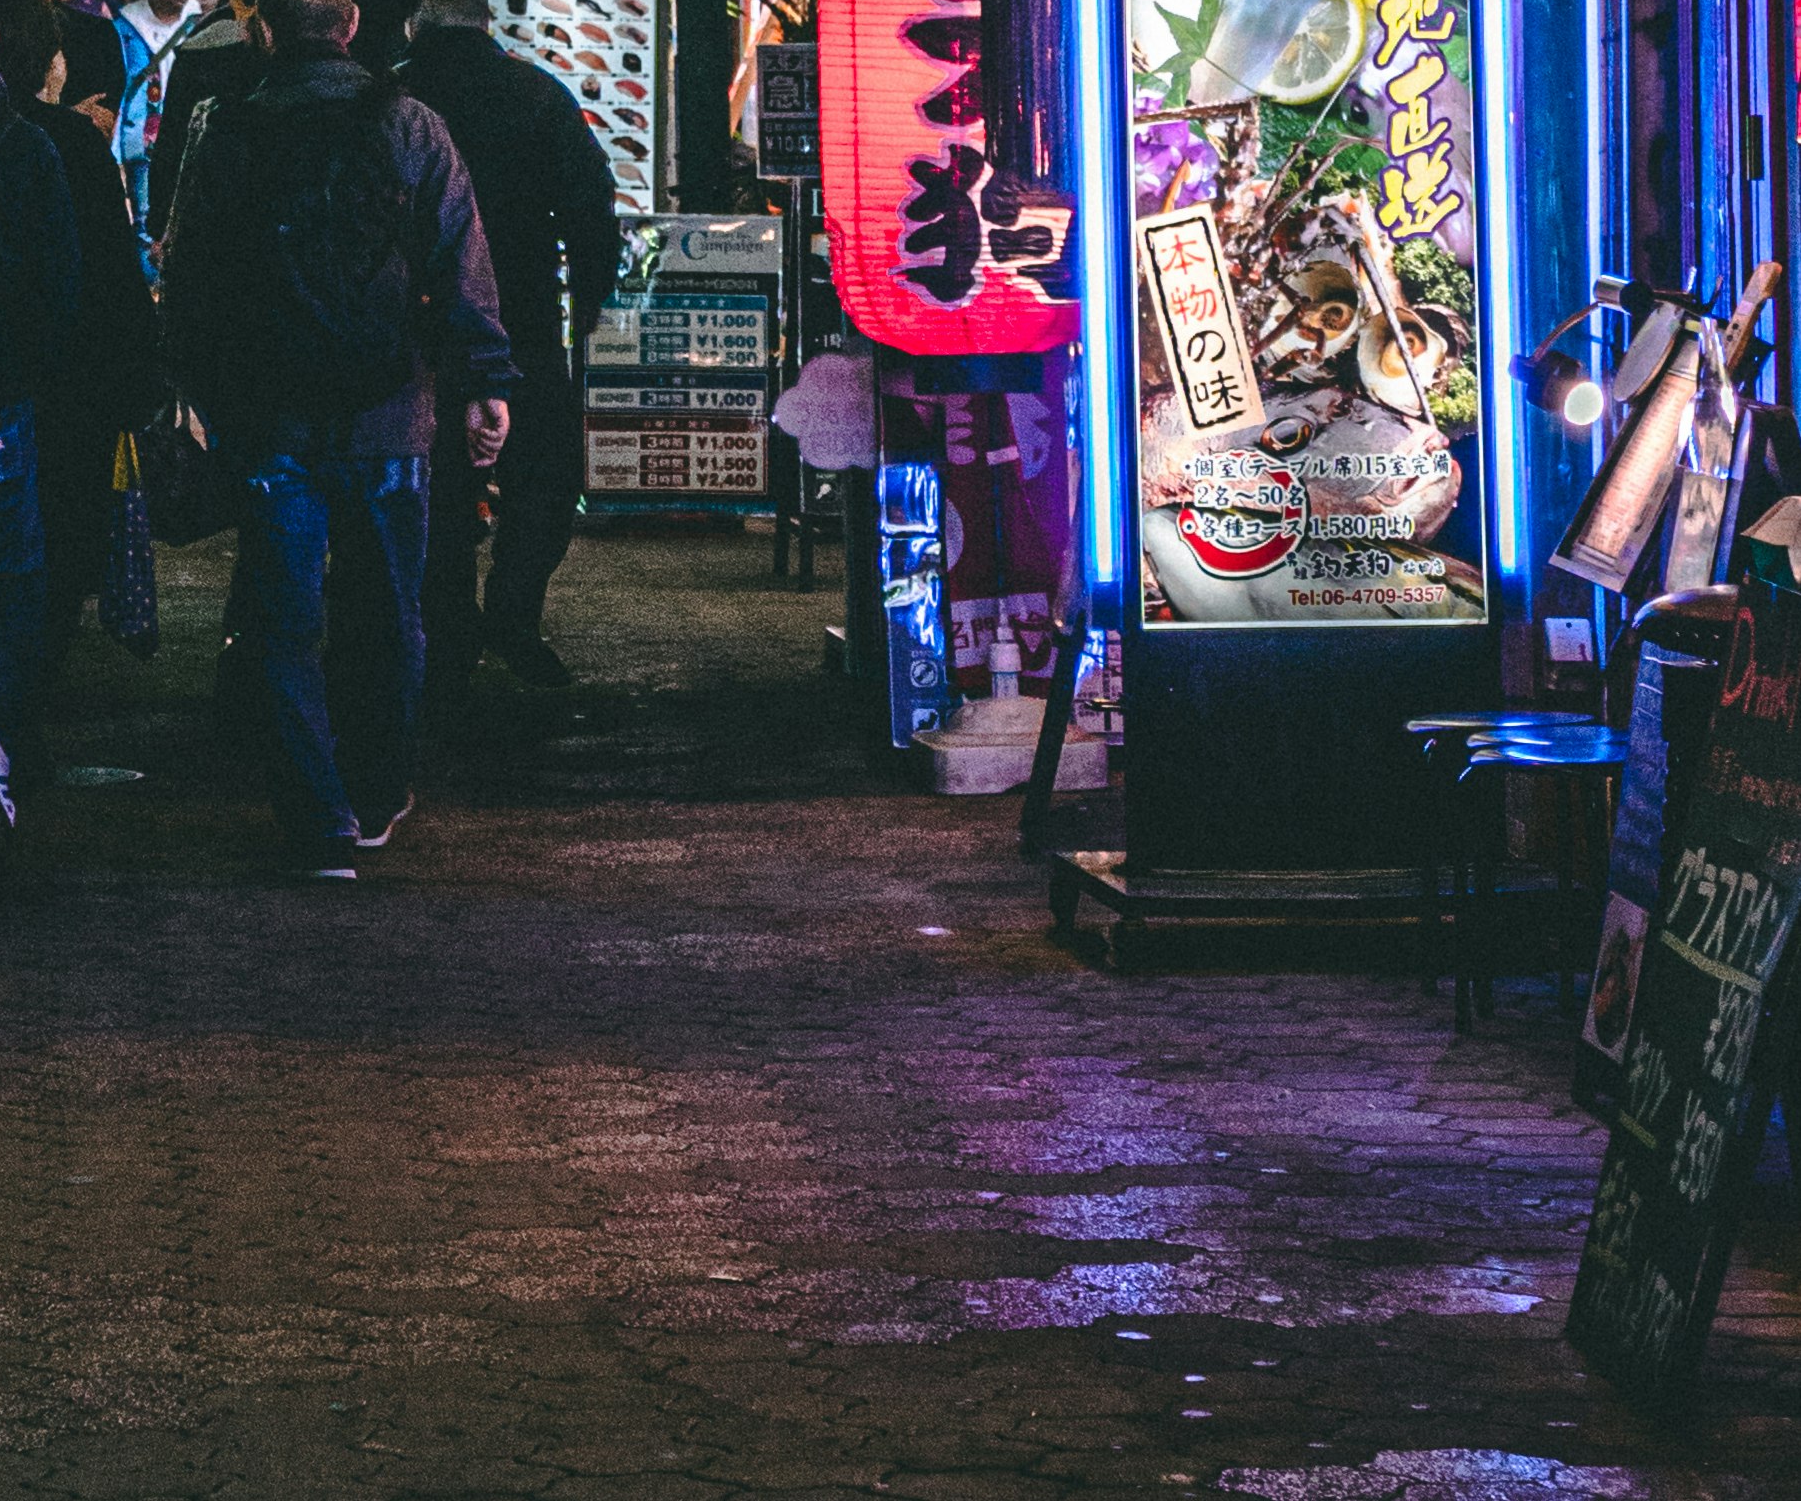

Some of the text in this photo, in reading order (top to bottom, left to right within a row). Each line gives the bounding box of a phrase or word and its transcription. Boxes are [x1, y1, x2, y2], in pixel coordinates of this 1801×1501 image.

[1159, 232, 1245, 411] 本物の味
[1194, 453, 1451, 480] 個室(テーブル席)15室完備
[1199, 515, 1415, 540] 各種コース 1,580円より
[1309, 551, 1393, 579] 釣天狗
[1287, 586, 1446, 608] Tel:06-4709-5357
